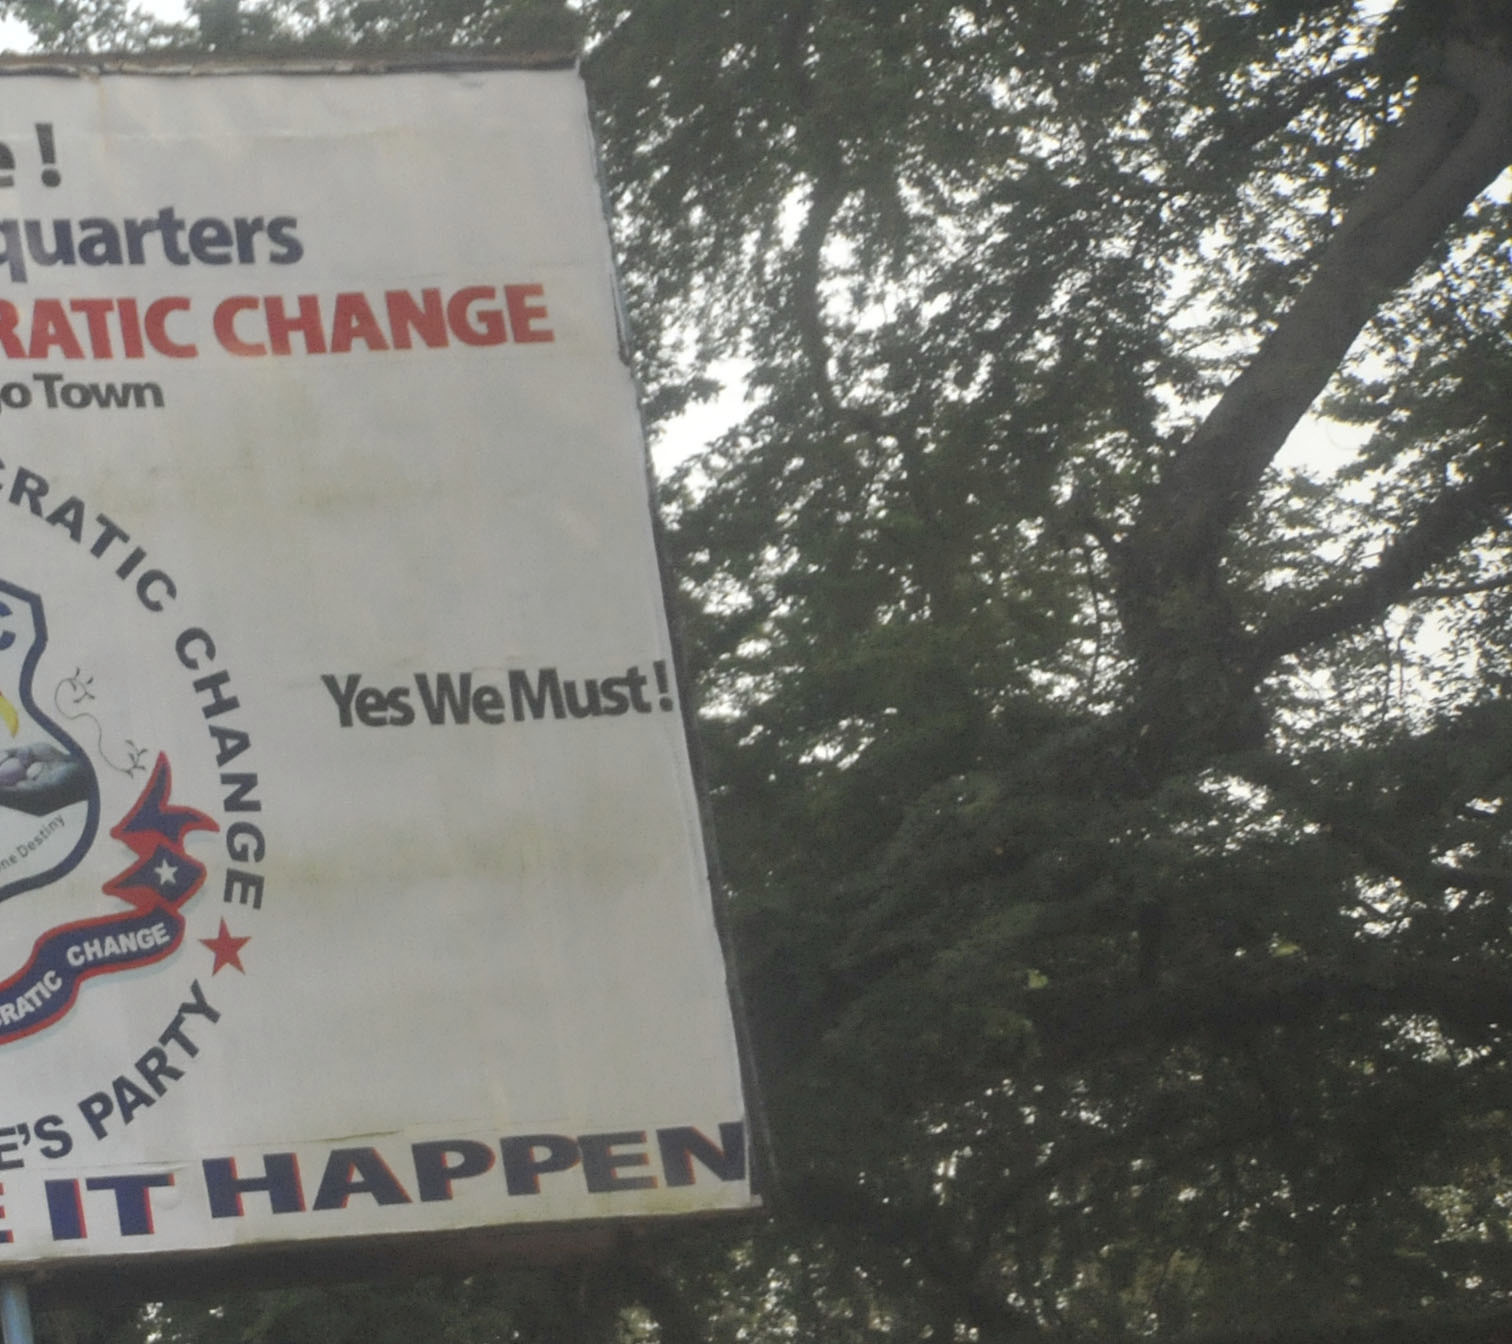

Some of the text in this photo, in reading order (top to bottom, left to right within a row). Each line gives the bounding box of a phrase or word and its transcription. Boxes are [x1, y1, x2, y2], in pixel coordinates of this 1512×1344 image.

[212, 283, 555, 356] CHANGE
[34, 372, 164, 410] Town
[321, 672, 415, 728] Yes
[414, 671, 505, 725] We
[175, 627, 265, 911] CHANGE
[16, 814, 66, 858] Destiny
[66, 923, 171, 967] CHANGE
[76, 980, 222, 1139] PARTY
[44, 1173, 175, 1242] IT
[201, 1121, 747, 1219] HAPPEN
